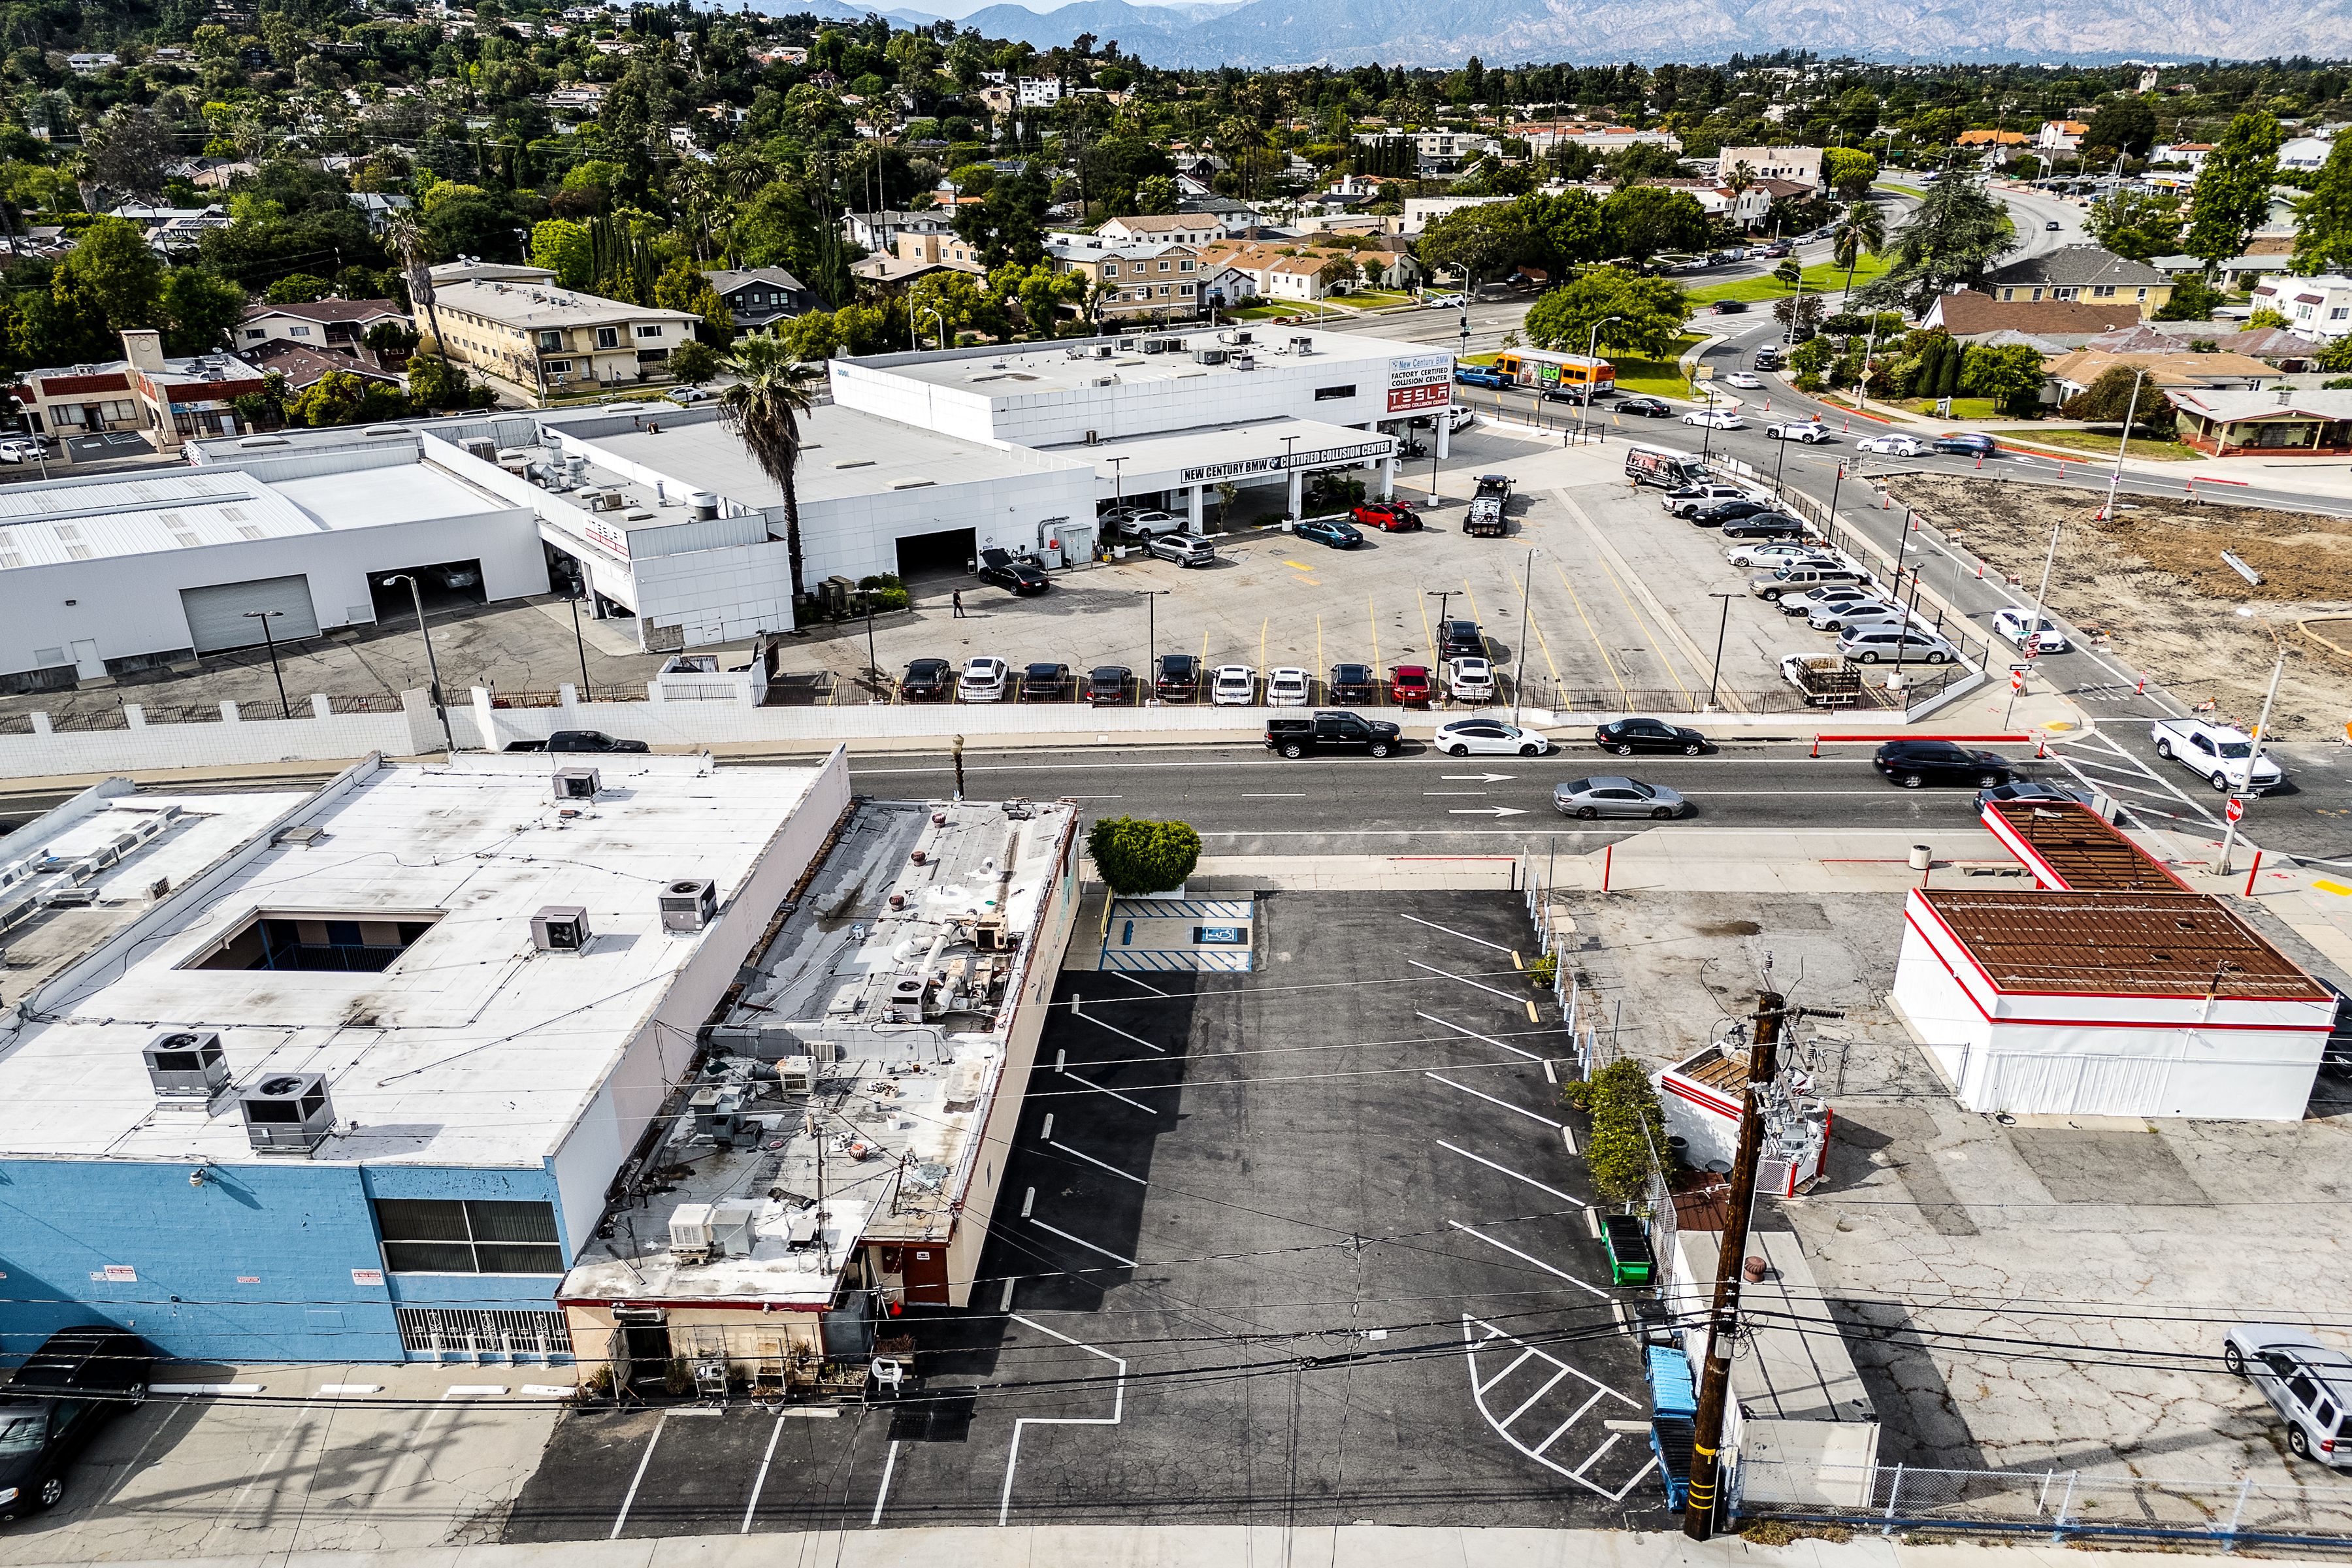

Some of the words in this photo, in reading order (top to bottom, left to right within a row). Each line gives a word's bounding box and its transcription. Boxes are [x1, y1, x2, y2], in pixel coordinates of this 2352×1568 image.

[1413, 358, 1433, 367] Century
[1436, 355, 1449, 365] BMW
[1392, 370, 1418, 379] FACTORY
[1421, 367, 1448, 376] CERTIFIED
[1392, 378, 1423, 387] COLLISION
[1389, 386, 1448, 404] TESLA
[1184, 468, 1204, 481] NEW
[1206, 463, 1244, 478] CENTURY
[1245, 459, 1267, 472] BMW
[1320, 446, 1360, 461] COLLISION
[1362, 441, 1390, 455] CENTER
[2227, 801, 2242, 816] STOP
